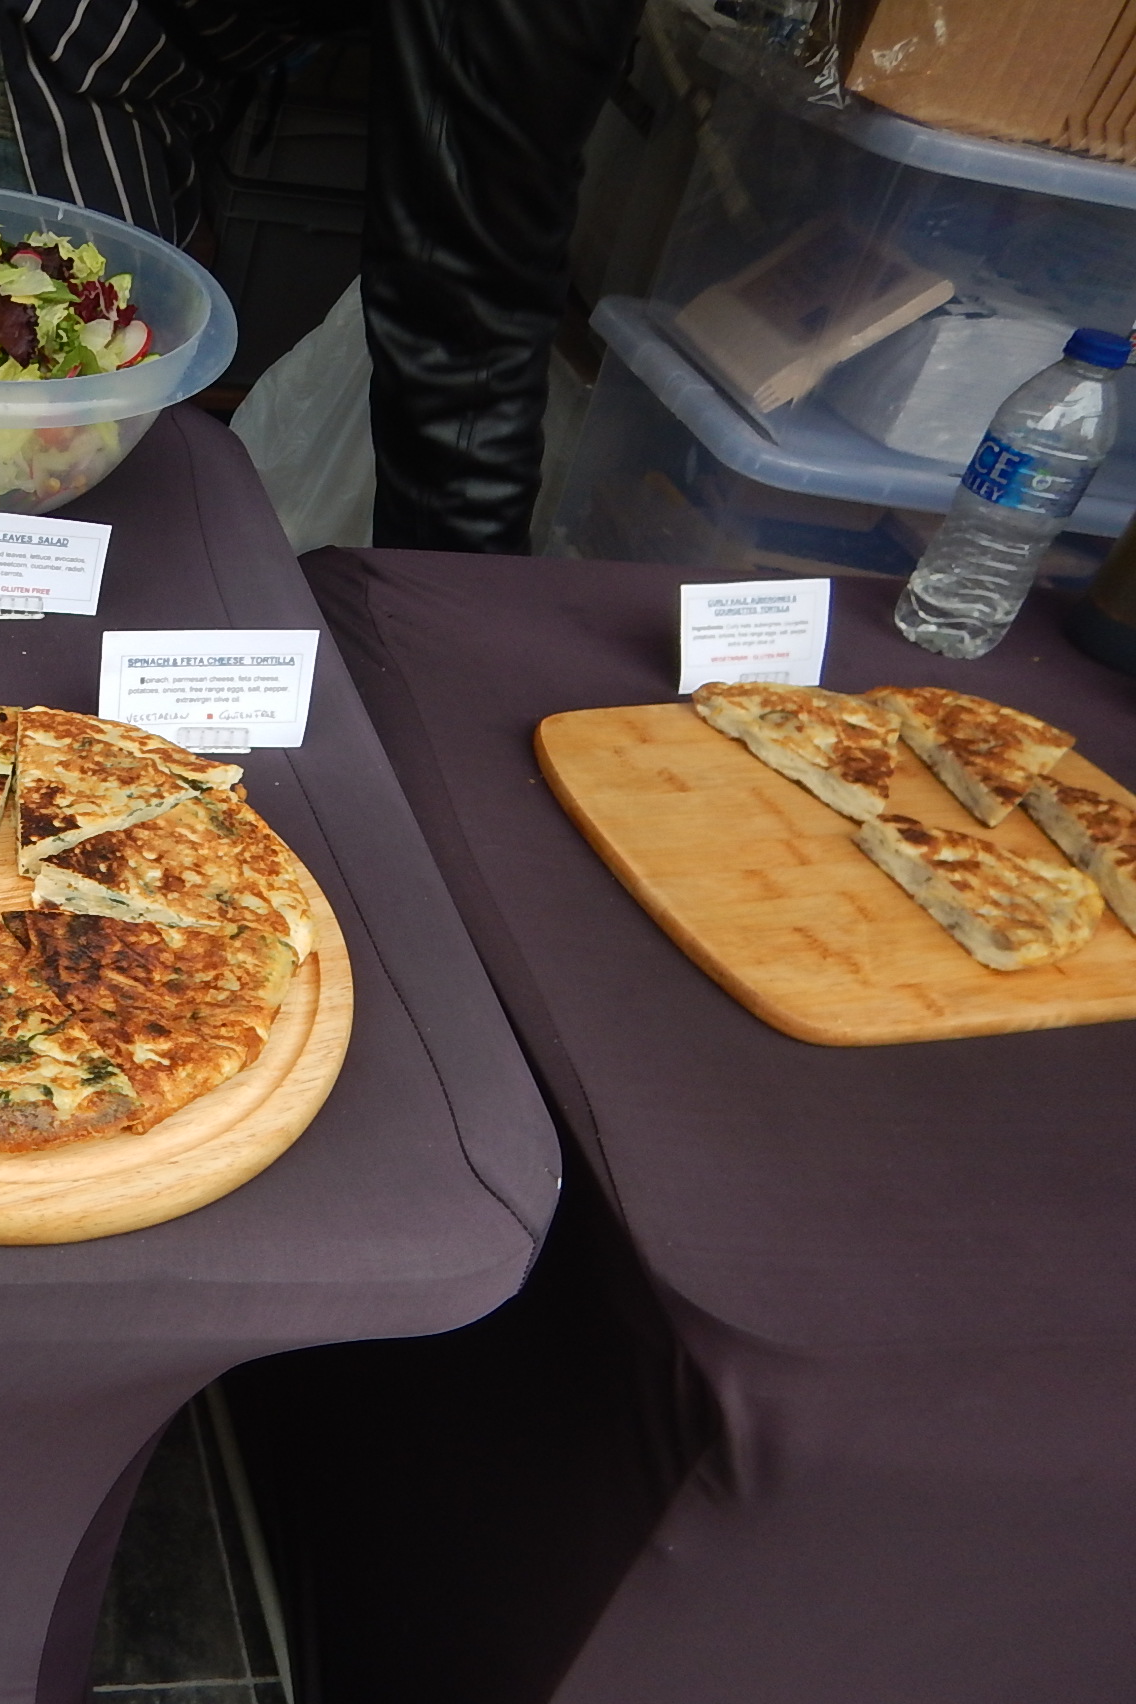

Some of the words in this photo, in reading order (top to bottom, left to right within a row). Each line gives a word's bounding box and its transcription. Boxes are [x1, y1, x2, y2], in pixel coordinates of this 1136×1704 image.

[37, 536, 70, 548] SALAD
[0, 585, 31, 594] GLUTEN
[31, 587, 51, 595] FREE
[127, 657, 171, 668] SPINACH
[172, 657, 178, 667] &
[180, 656, 205, 667] FETA
[206, 656, 246, 667] CHEESE
[250, 656, 295, 666] TORTILLA
[204, 686, 225, 694] range
